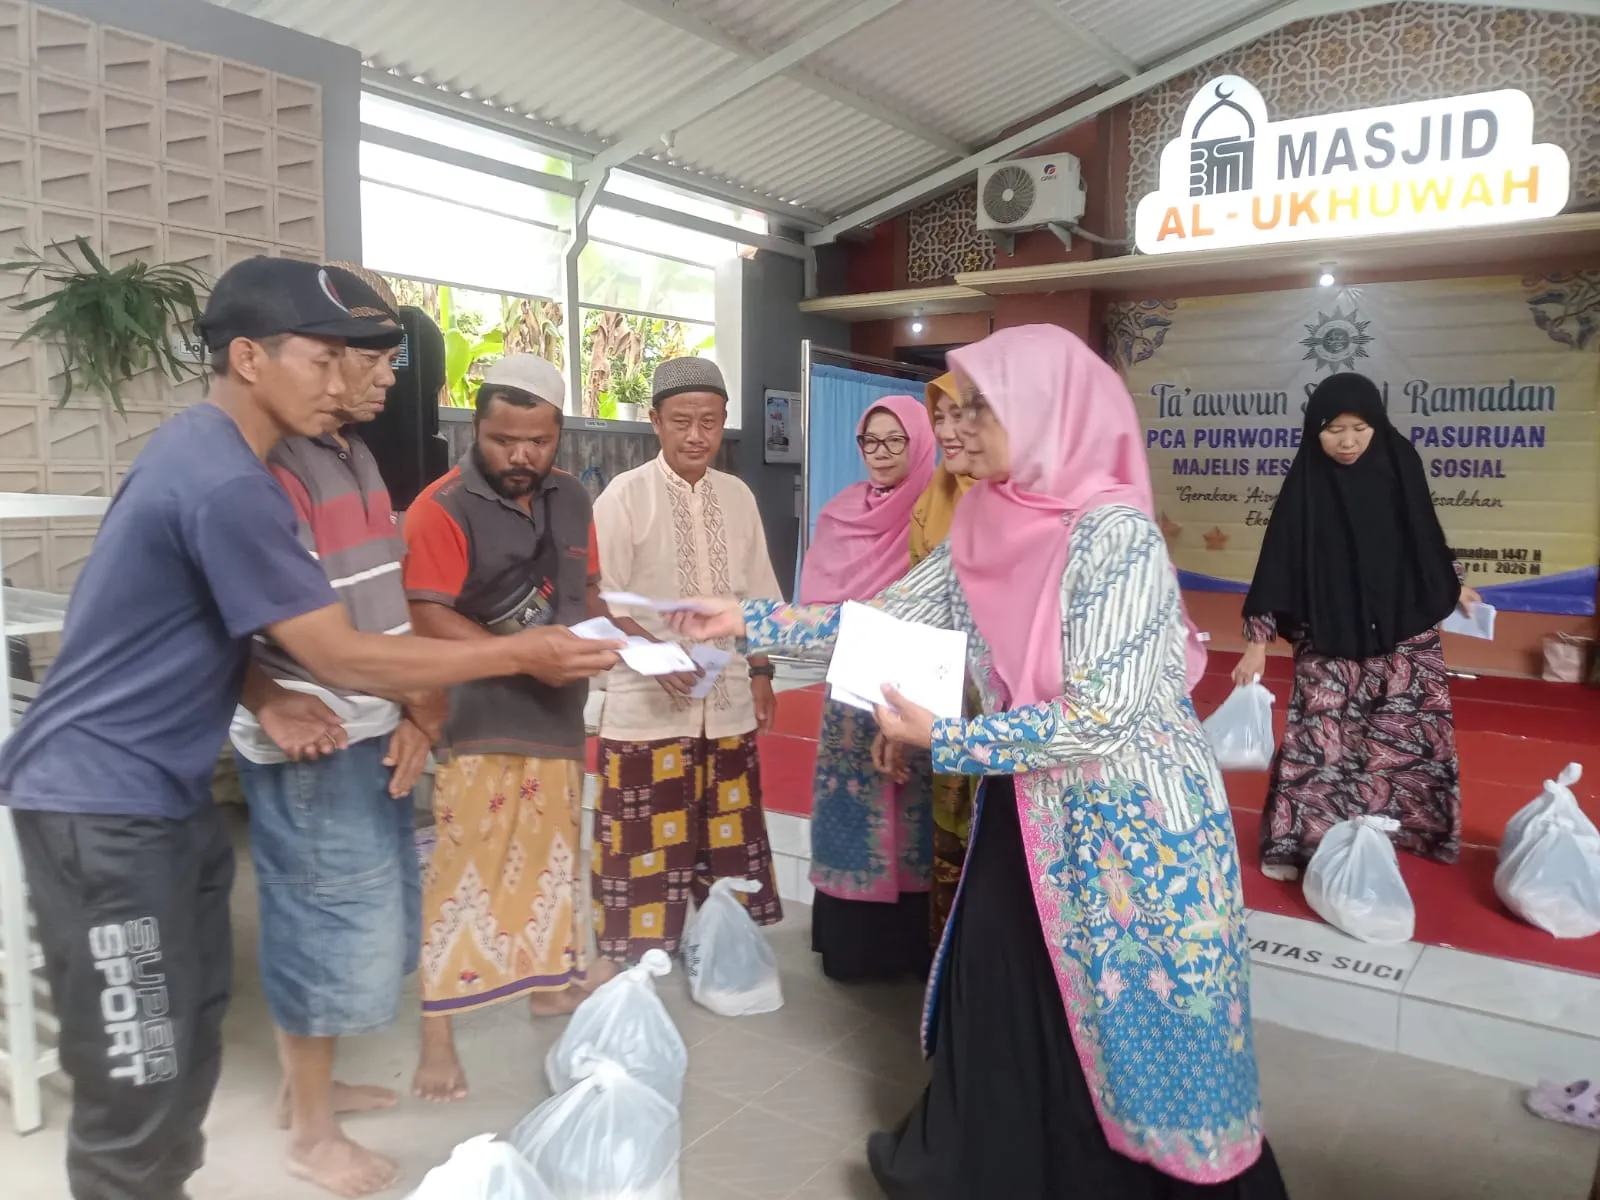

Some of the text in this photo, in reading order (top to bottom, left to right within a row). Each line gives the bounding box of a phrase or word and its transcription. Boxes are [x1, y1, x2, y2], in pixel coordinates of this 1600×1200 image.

[1276, 108, 1499, 181] MASJID
[1151, 383, 1288, 418] Ta'awwun
[1403, 378, 1556, 416] Ramadan
[1146, 425, 1546, 449] PCA PURWORE PASURUAN
[1172, 458, 1506, 478] MAJELIS KES SOSIAL
[1464, 562, 1488, 573] ret
[1495, 561, 1527, 575] 2026
[1501, 548, 1529, 560] 1447
[1248, 936, 1405, 982] ATAS SUCI
[88, 924, 147, 1086] SPORT
